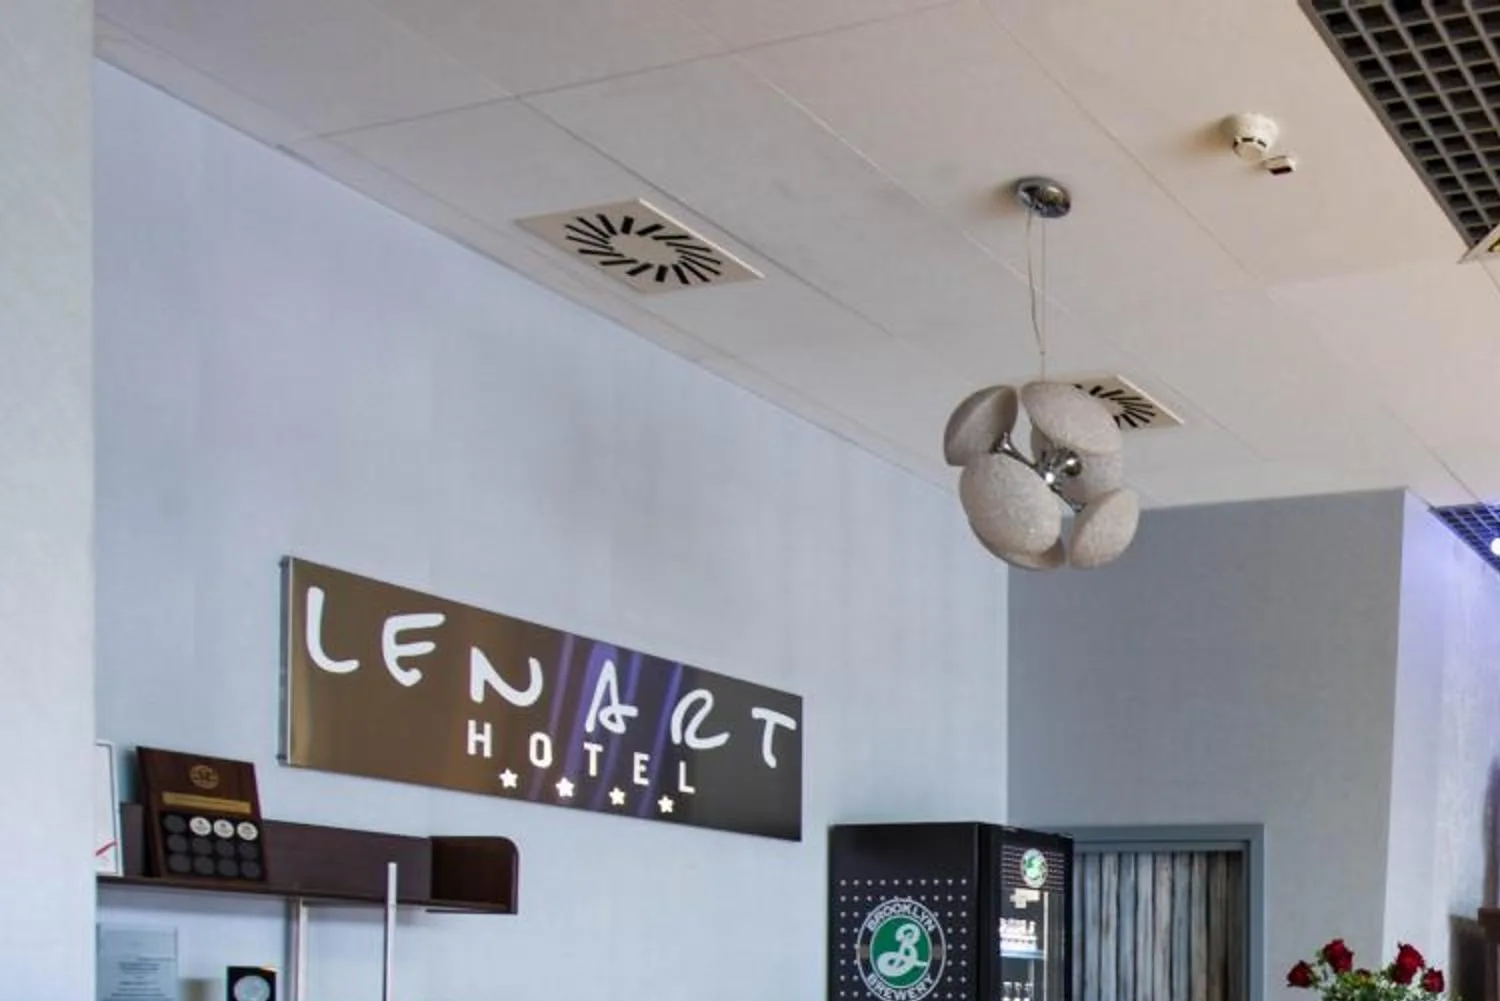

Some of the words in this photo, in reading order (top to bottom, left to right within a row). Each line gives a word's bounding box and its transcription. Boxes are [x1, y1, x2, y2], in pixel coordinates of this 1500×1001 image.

[306, 586, 797, 768] LENART
[467, 720, 695, 794] HOTEL
[867, 903, 936, 932] BROOKLYN
[867, 973, 933, 1001] BREWERY
